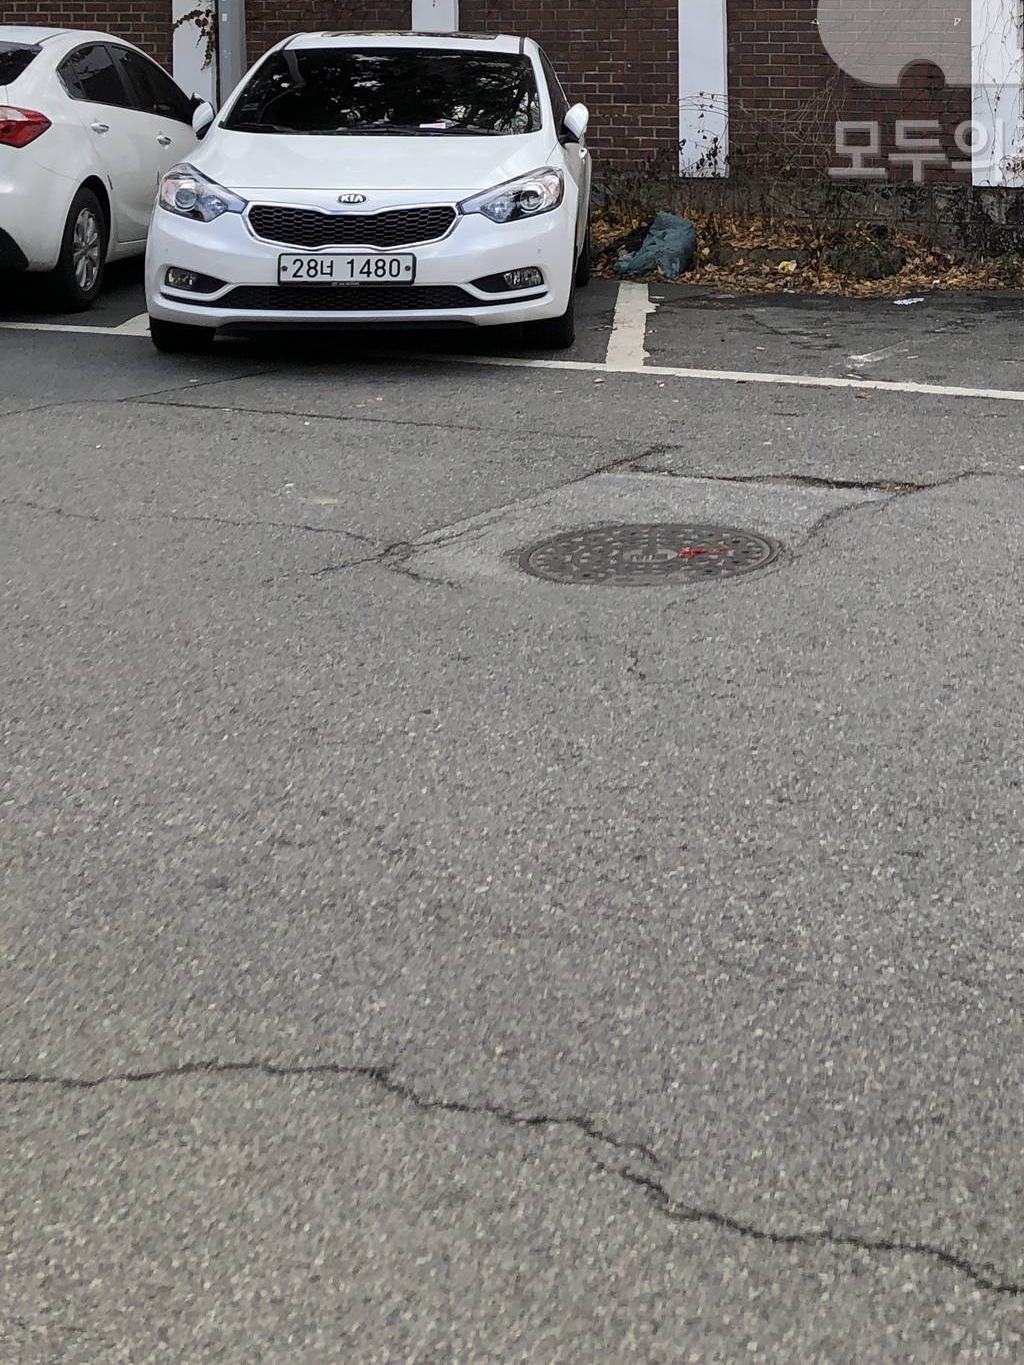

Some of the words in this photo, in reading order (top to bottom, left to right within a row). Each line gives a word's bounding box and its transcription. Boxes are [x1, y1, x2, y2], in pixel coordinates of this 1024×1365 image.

[340, 194, 364, 203] KIA
[292, 258, 334, 278] 28너
[346, 258, 401, 278] 1480
